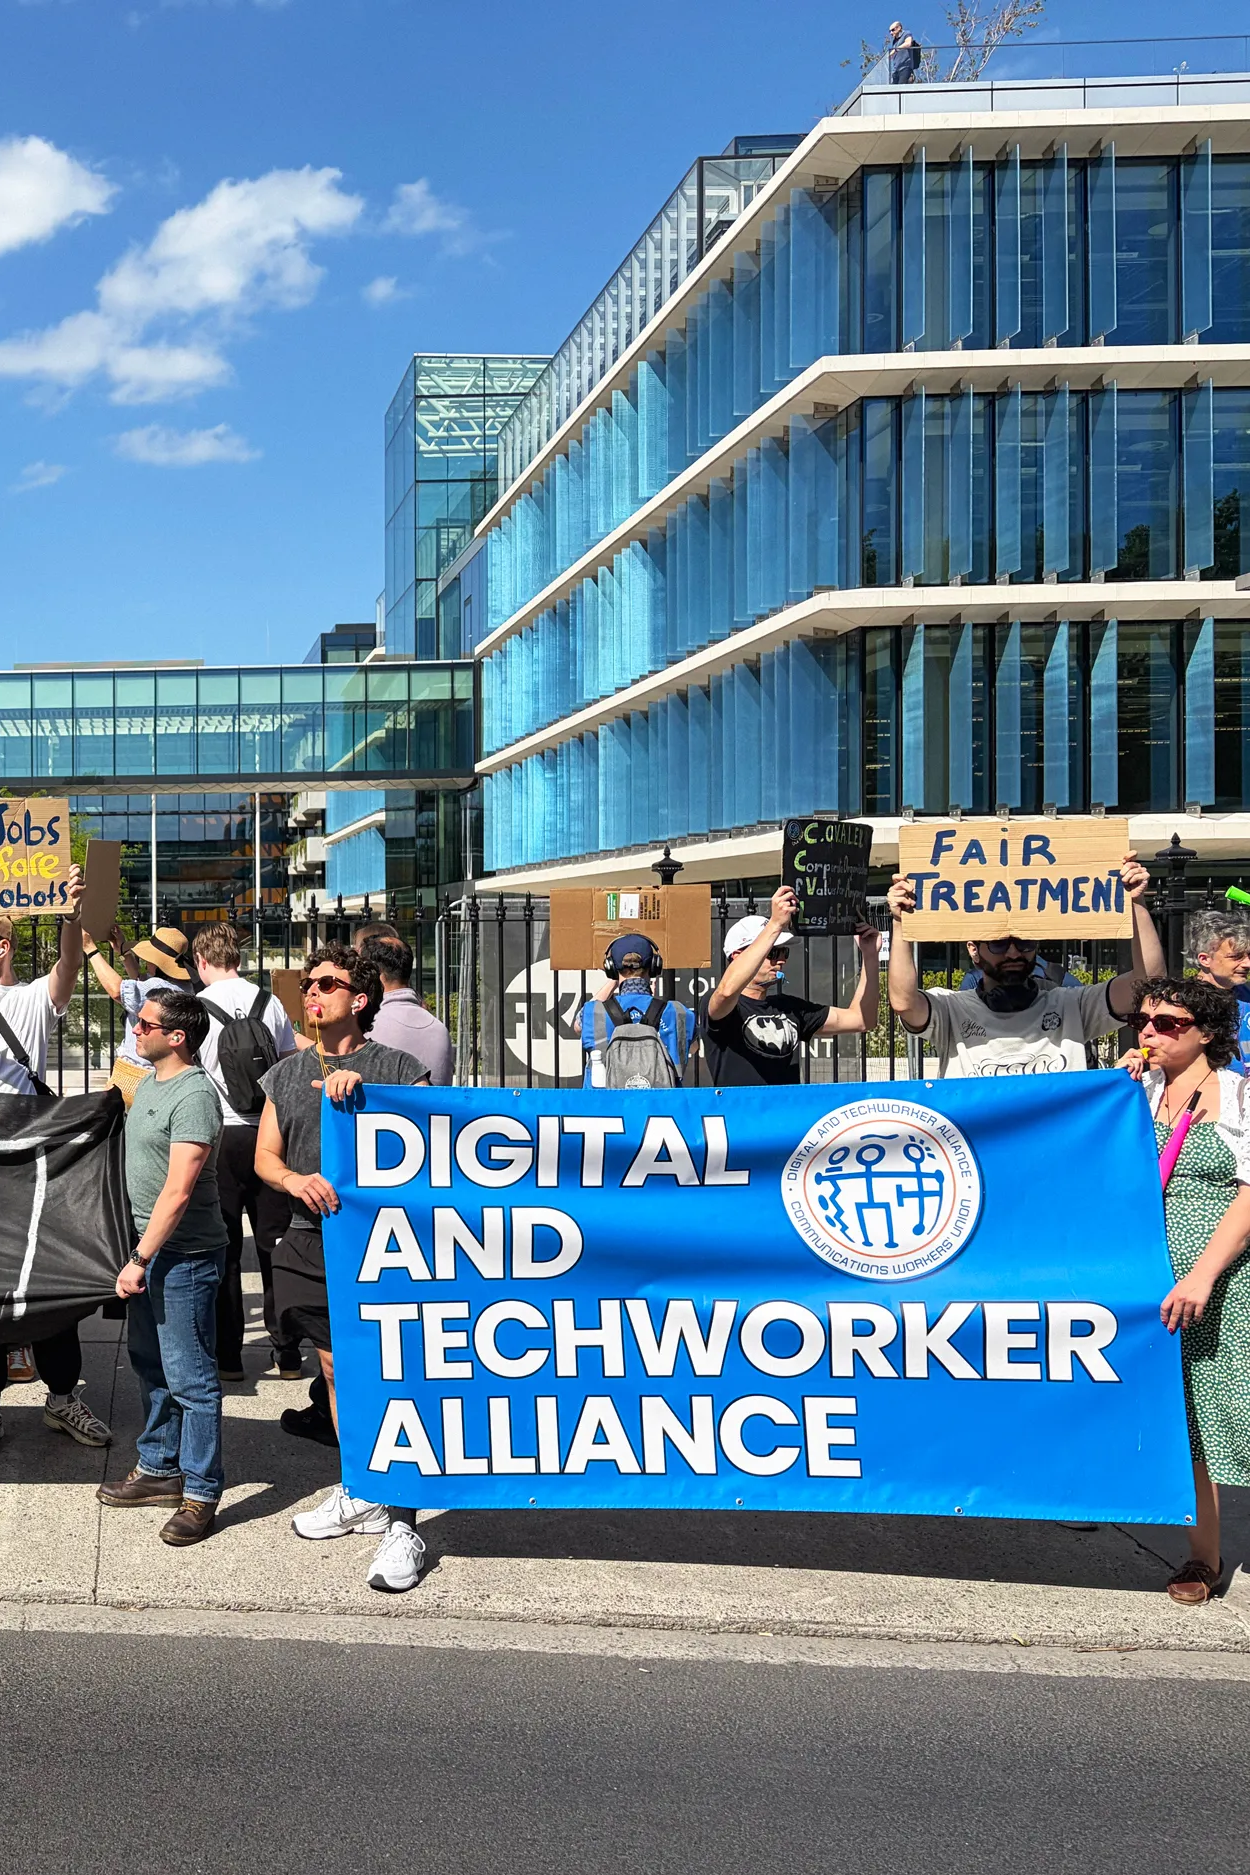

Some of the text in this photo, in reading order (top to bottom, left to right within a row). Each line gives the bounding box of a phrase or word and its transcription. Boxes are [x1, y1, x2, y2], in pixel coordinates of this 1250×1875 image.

[798, 901, 828, 924] Less
[907, 869, 1125, 914] TREATMENT
[355, 1111, 750, 1189] DIGITAL
[787, 1103, 972, 1181] DIGITAL AND TECHWORKER ALLIANCE
[356, 1205, 584, 1283] AND
[790, 1198, 972, 1276] COMMUNICATIONS WORKERS' UNION
[358, 1298, 1123, 1383] TECHWORKER
[367, 1394, 863, 1479] ALLIANCE
